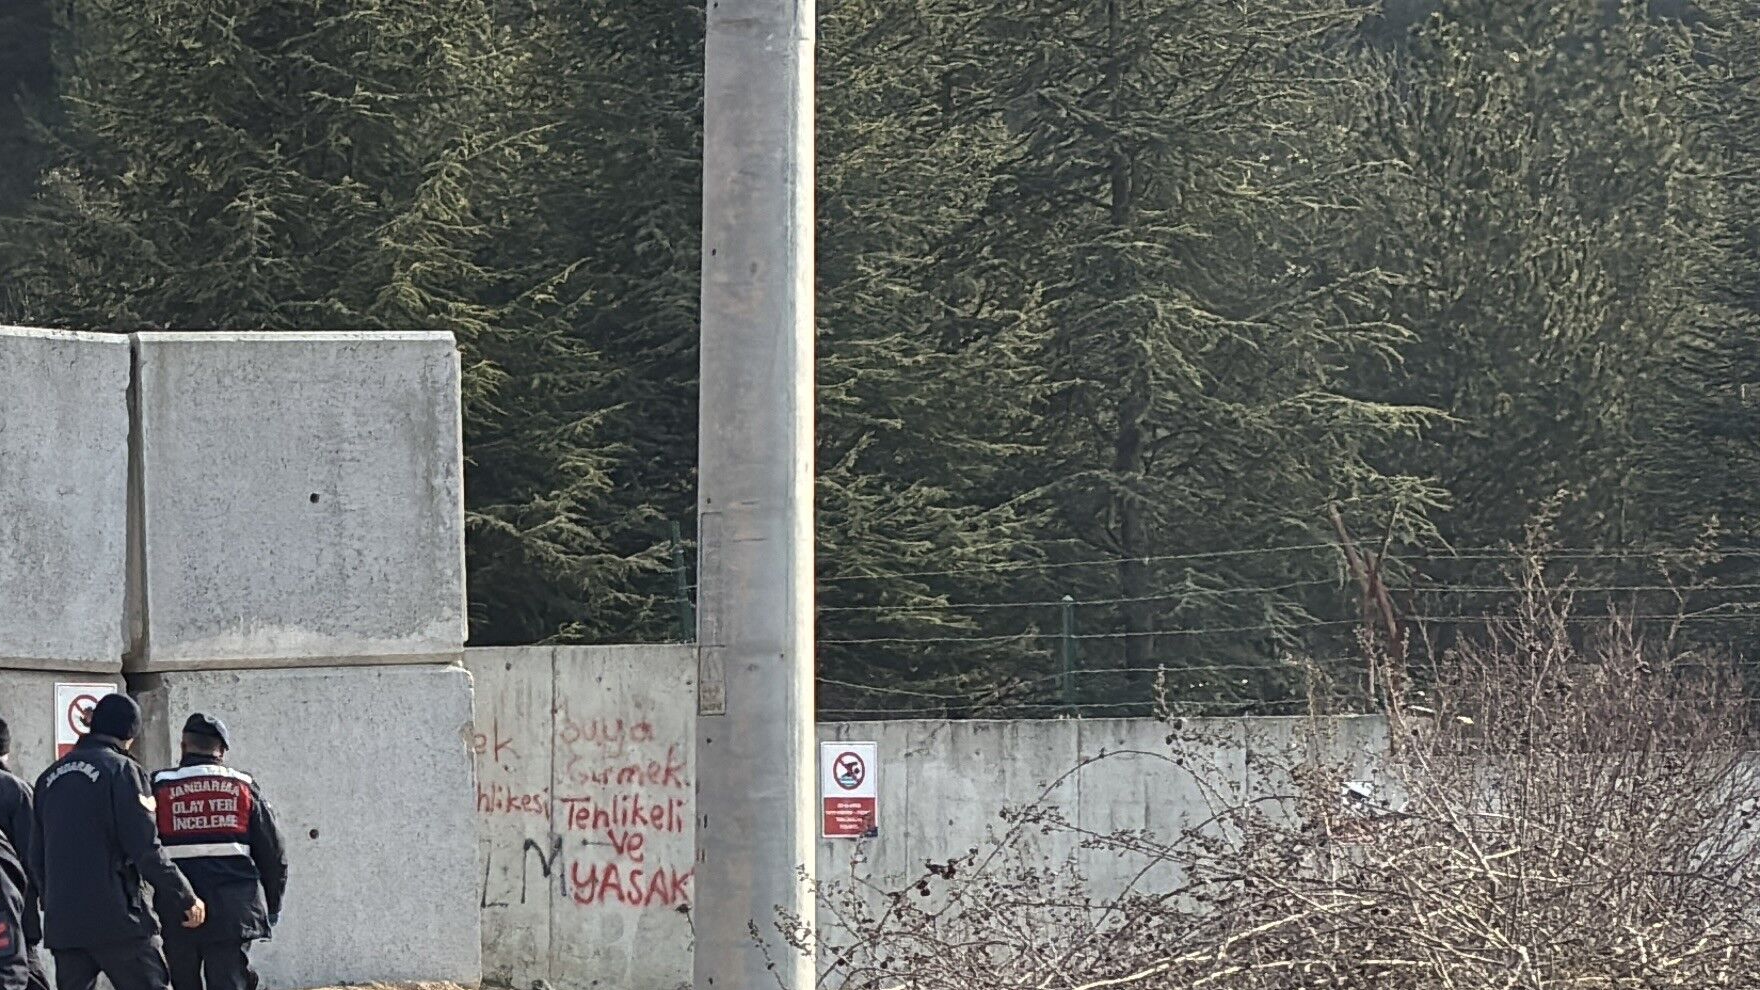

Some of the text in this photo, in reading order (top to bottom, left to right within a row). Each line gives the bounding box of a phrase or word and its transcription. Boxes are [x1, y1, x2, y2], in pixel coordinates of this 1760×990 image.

[45, 760, 100, 789] JANDARMA
[170, 780, 240, 800] JANDARMA
[172, 800, 205, 814] OLAY
[173, 814, 237, 831] İNCELEME
[570, 861, 695, 906] YASAK
